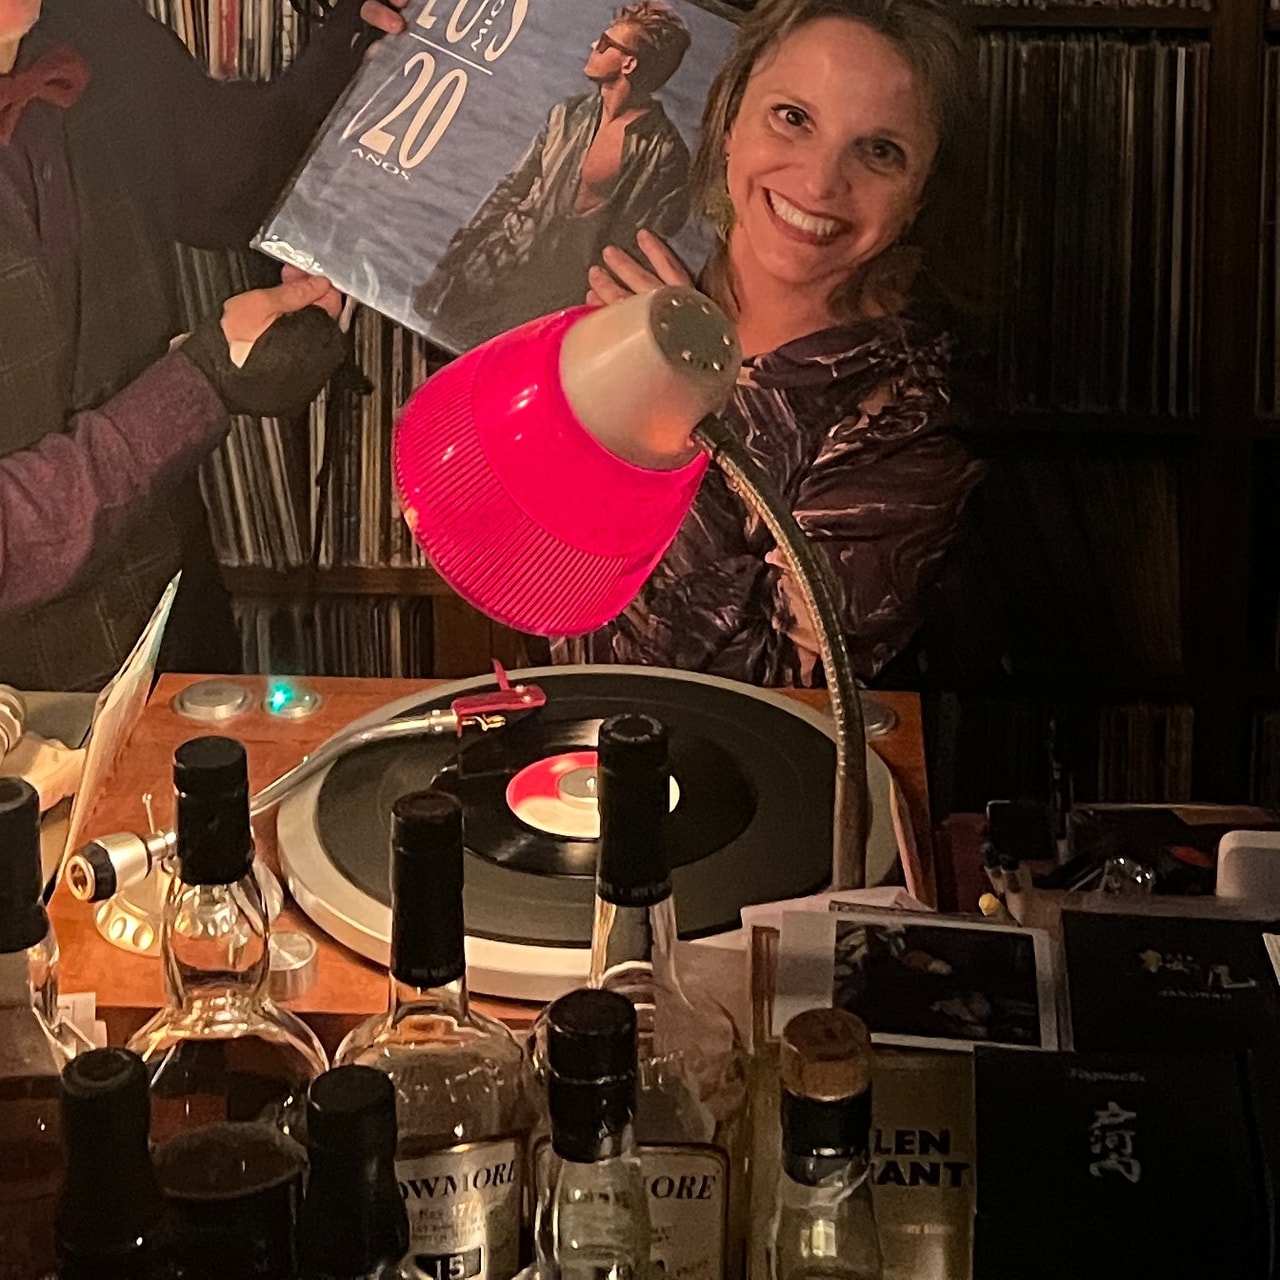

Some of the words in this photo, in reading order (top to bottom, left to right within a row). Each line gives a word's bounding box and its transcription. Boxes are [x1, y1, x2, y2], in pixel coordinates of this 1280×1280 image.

[358, 51, 468, 170] 20
[873, 1128, 951, 1156] LEN
[870, 1160, 971, 1187] ANT
[435, 1254, 465, 1280] 15
